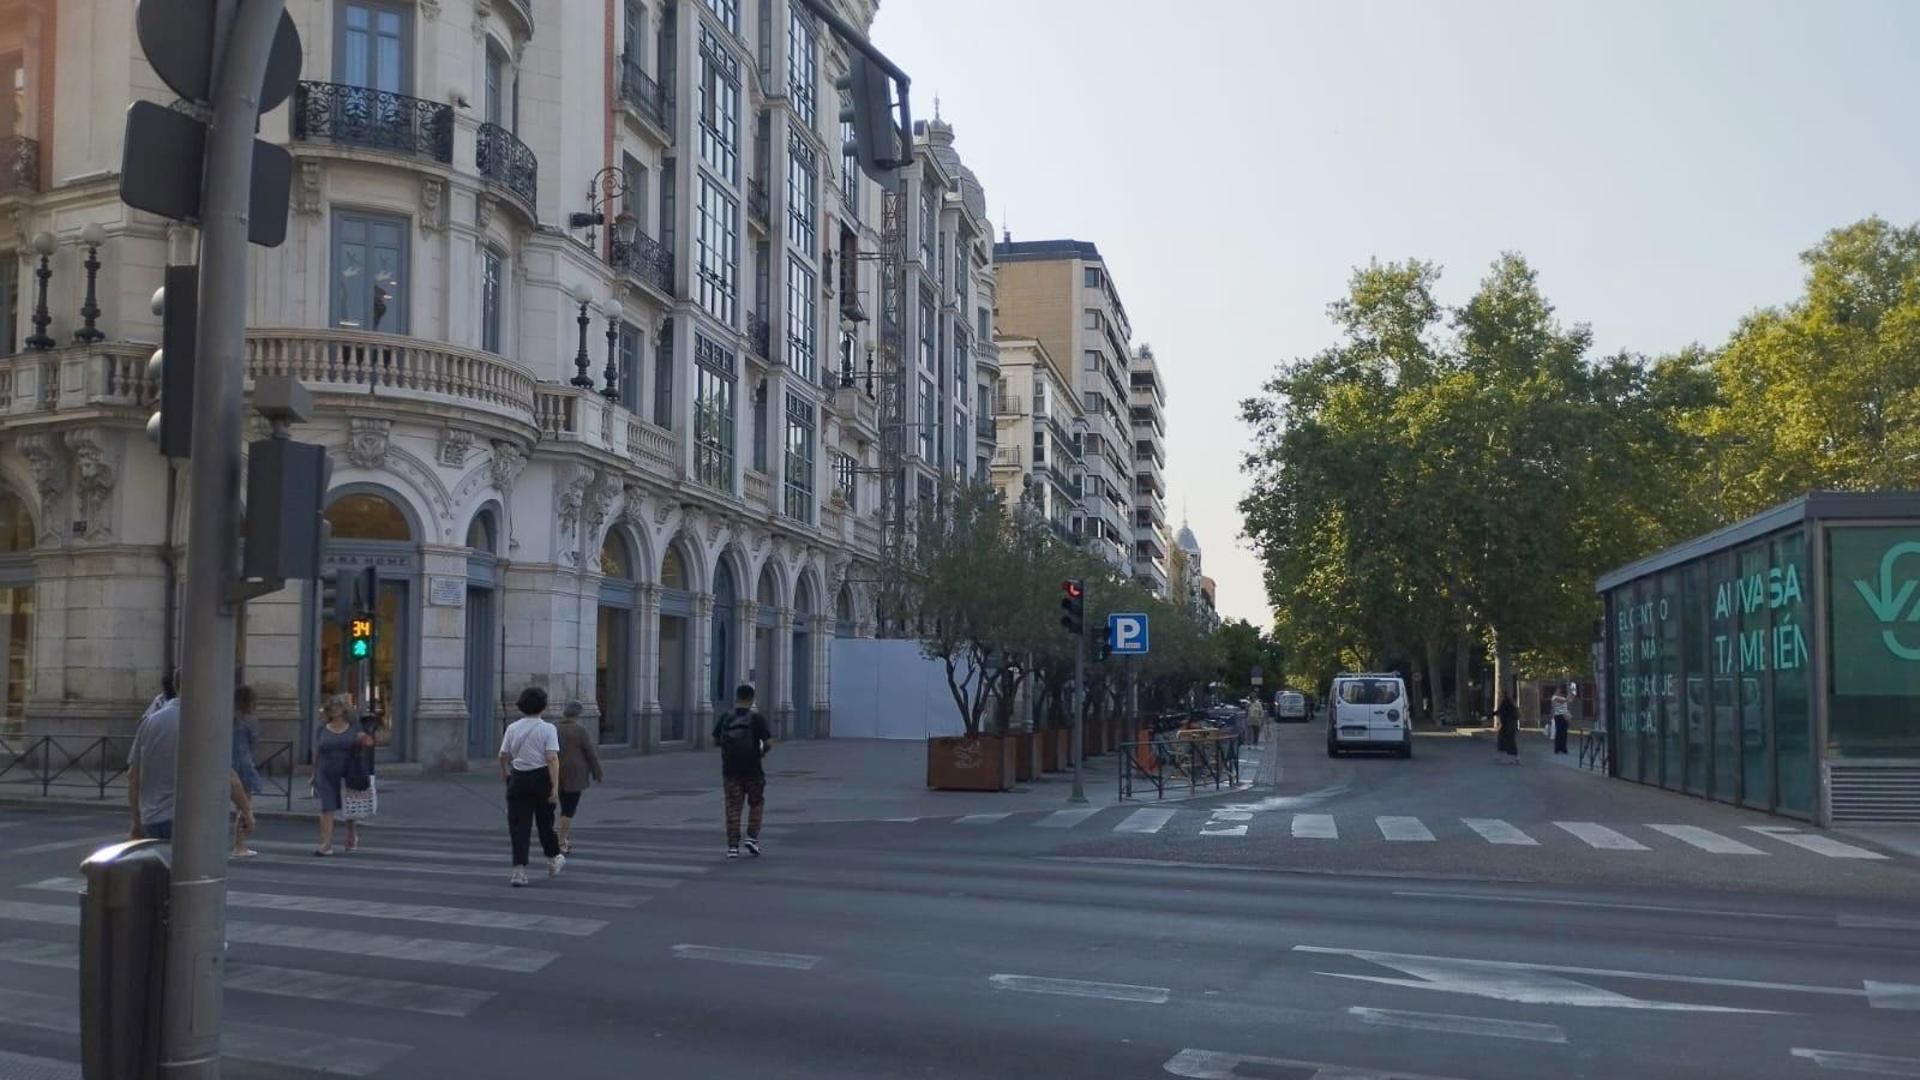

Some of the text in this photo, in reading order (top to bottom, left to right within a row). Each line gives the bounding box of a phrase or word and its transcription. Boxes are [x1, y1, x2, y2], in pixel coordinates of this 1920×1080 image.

[1629, 598, 1668, 627] CNTO
[352, 620, 370, 637] 34
[1116, 617, 1140, 649] P
